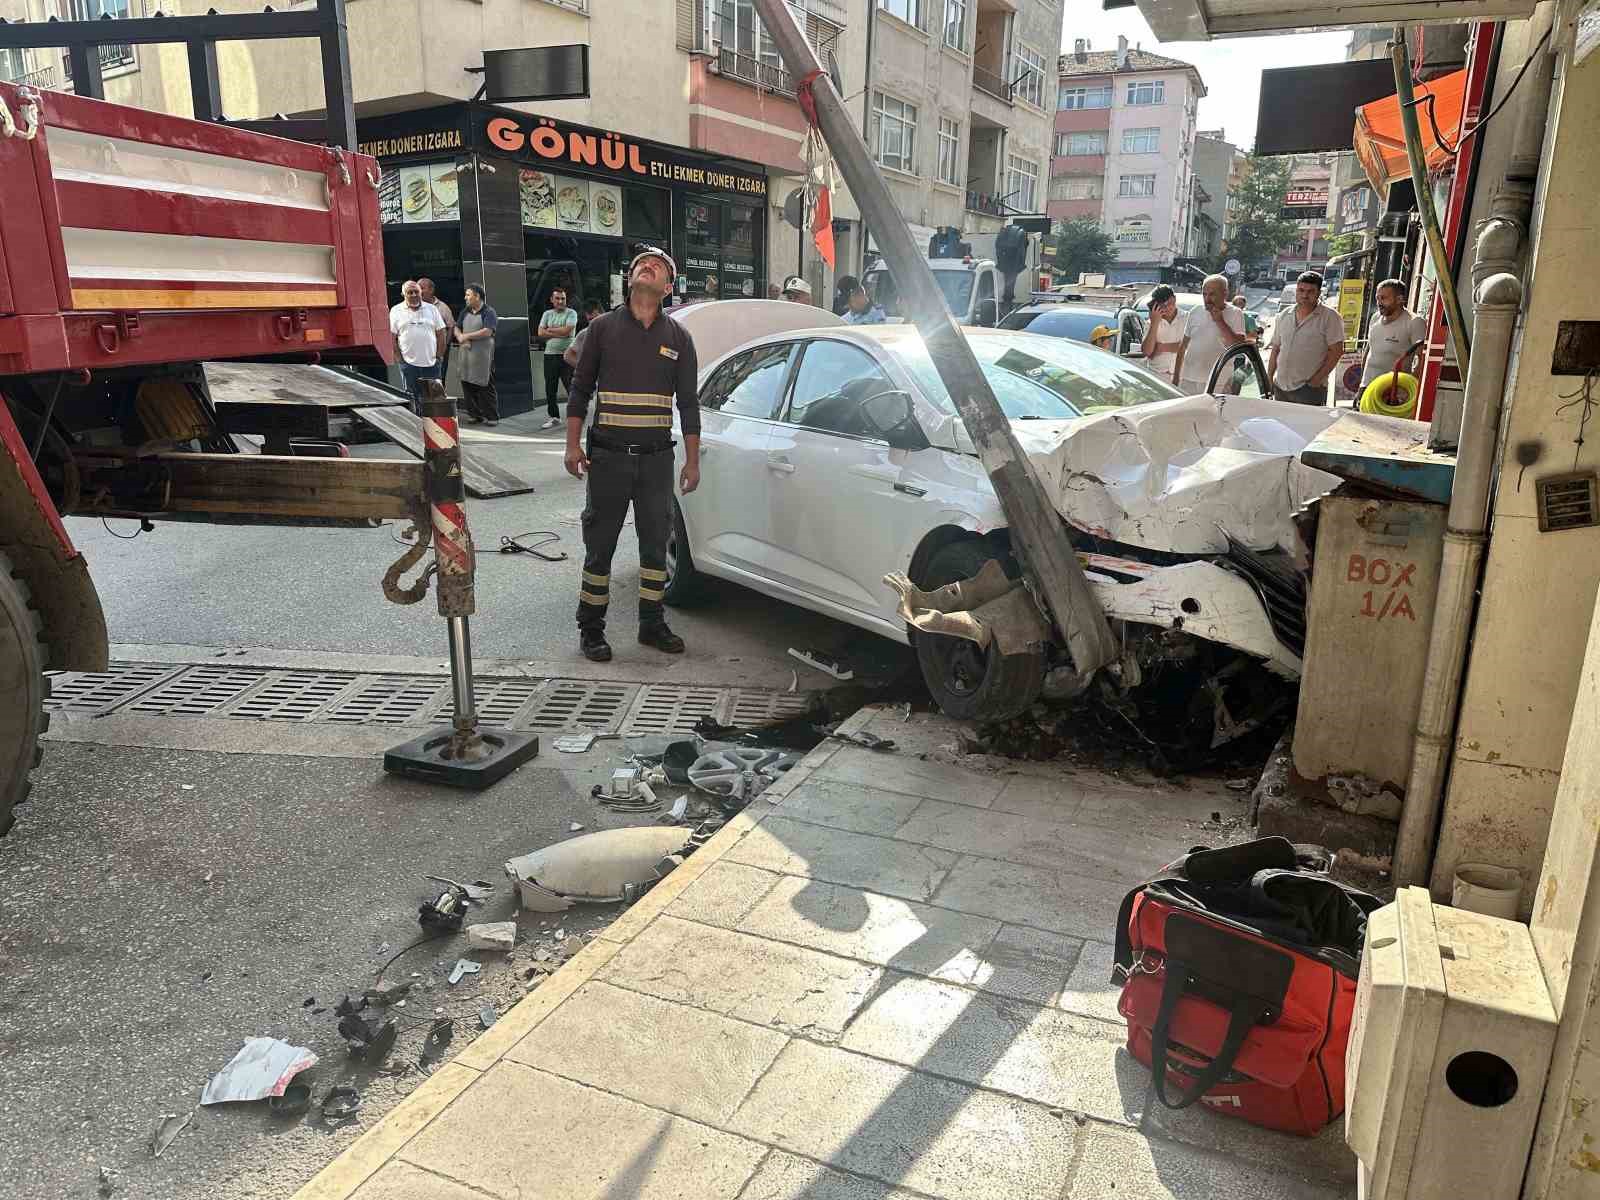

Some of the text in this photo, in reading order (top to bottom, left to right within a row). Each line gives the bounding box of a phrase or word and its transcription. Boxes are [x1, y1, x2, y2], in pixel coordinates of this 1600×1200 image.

[424, 130, 461, 150] IZGARA
[487, 118, 647, 174] GÖNÜL
[674, 165, 705, 184] EKMEK
[736, 177, 766, 195] IZGARA
[1347, 554, 1416, 588] BOX
[1360, 591, 1416, 621] 1/A
